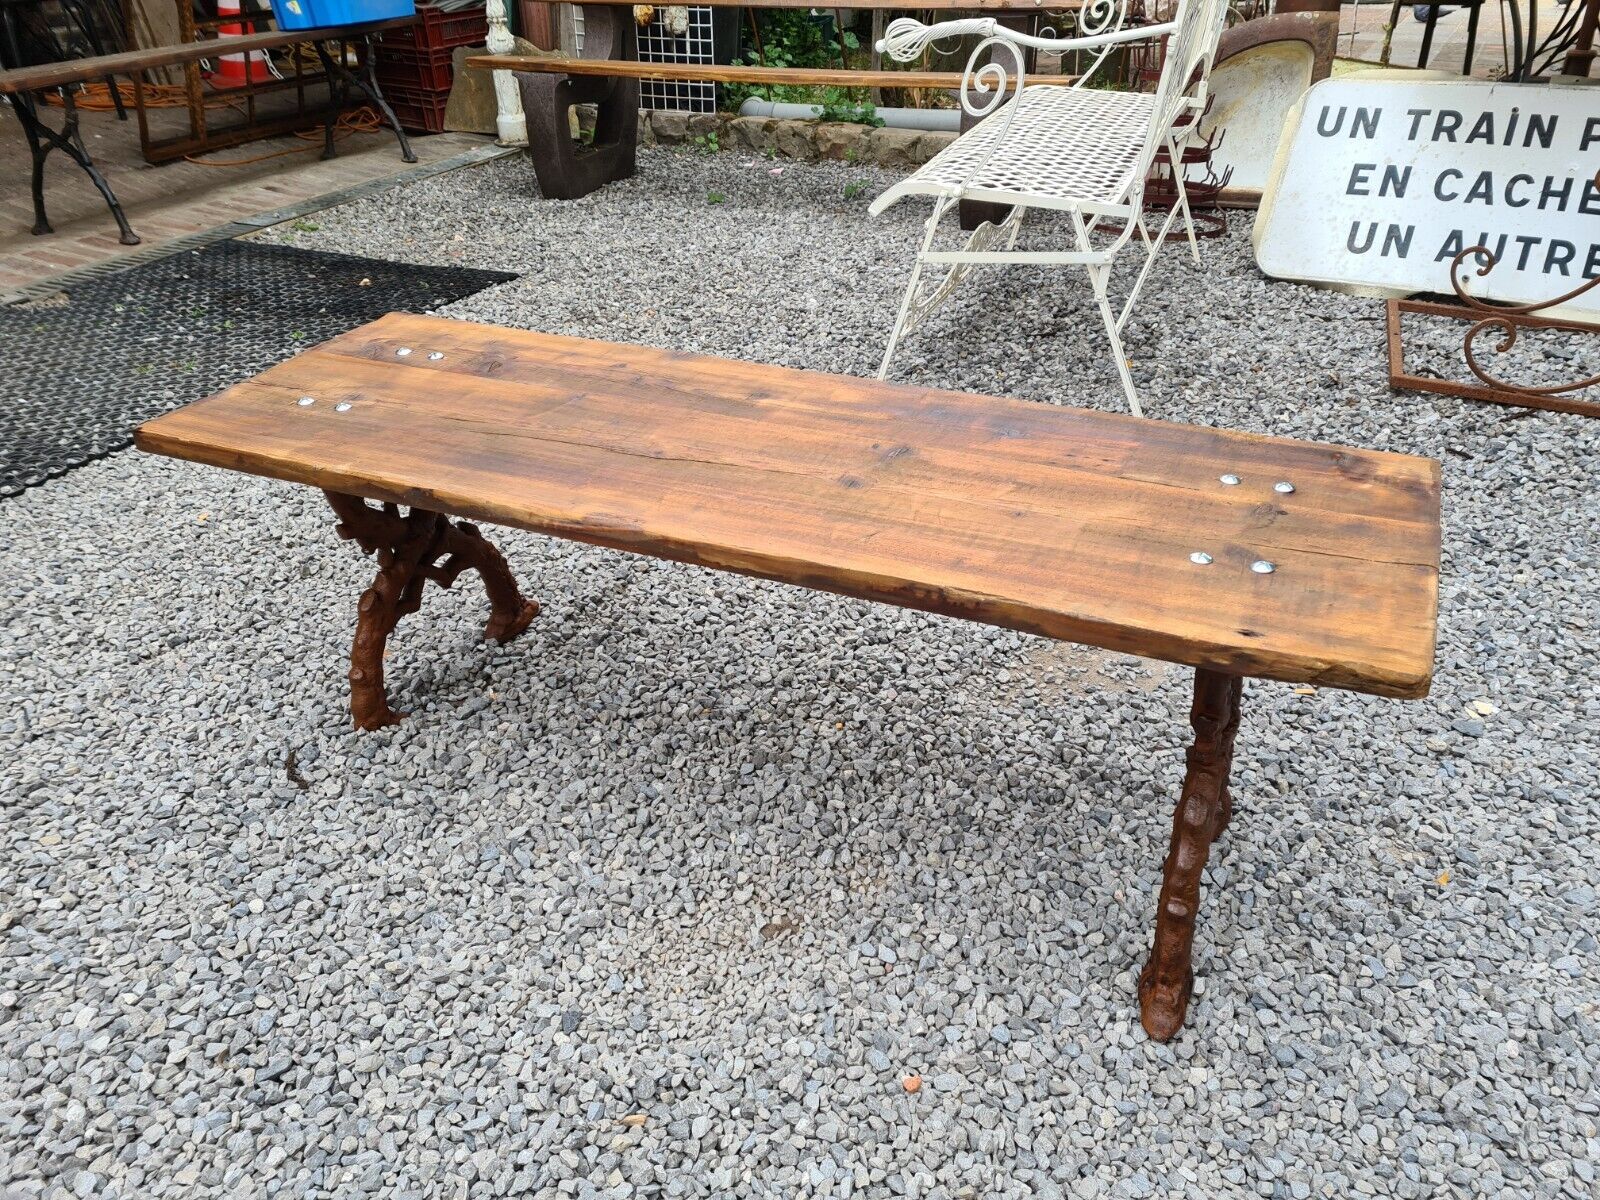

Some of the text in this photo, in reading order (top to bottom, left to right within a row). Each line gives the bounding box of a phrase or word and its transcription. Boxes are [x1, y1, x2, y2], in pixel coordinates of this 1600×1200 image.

[1316, 105, 1382, 139] UN
[1406, 108, 1559, 149] TRAIN
[1346, 163, 1600, 215] EN CACHE
[1346, 221, 1600, 279] UN AUTRE
